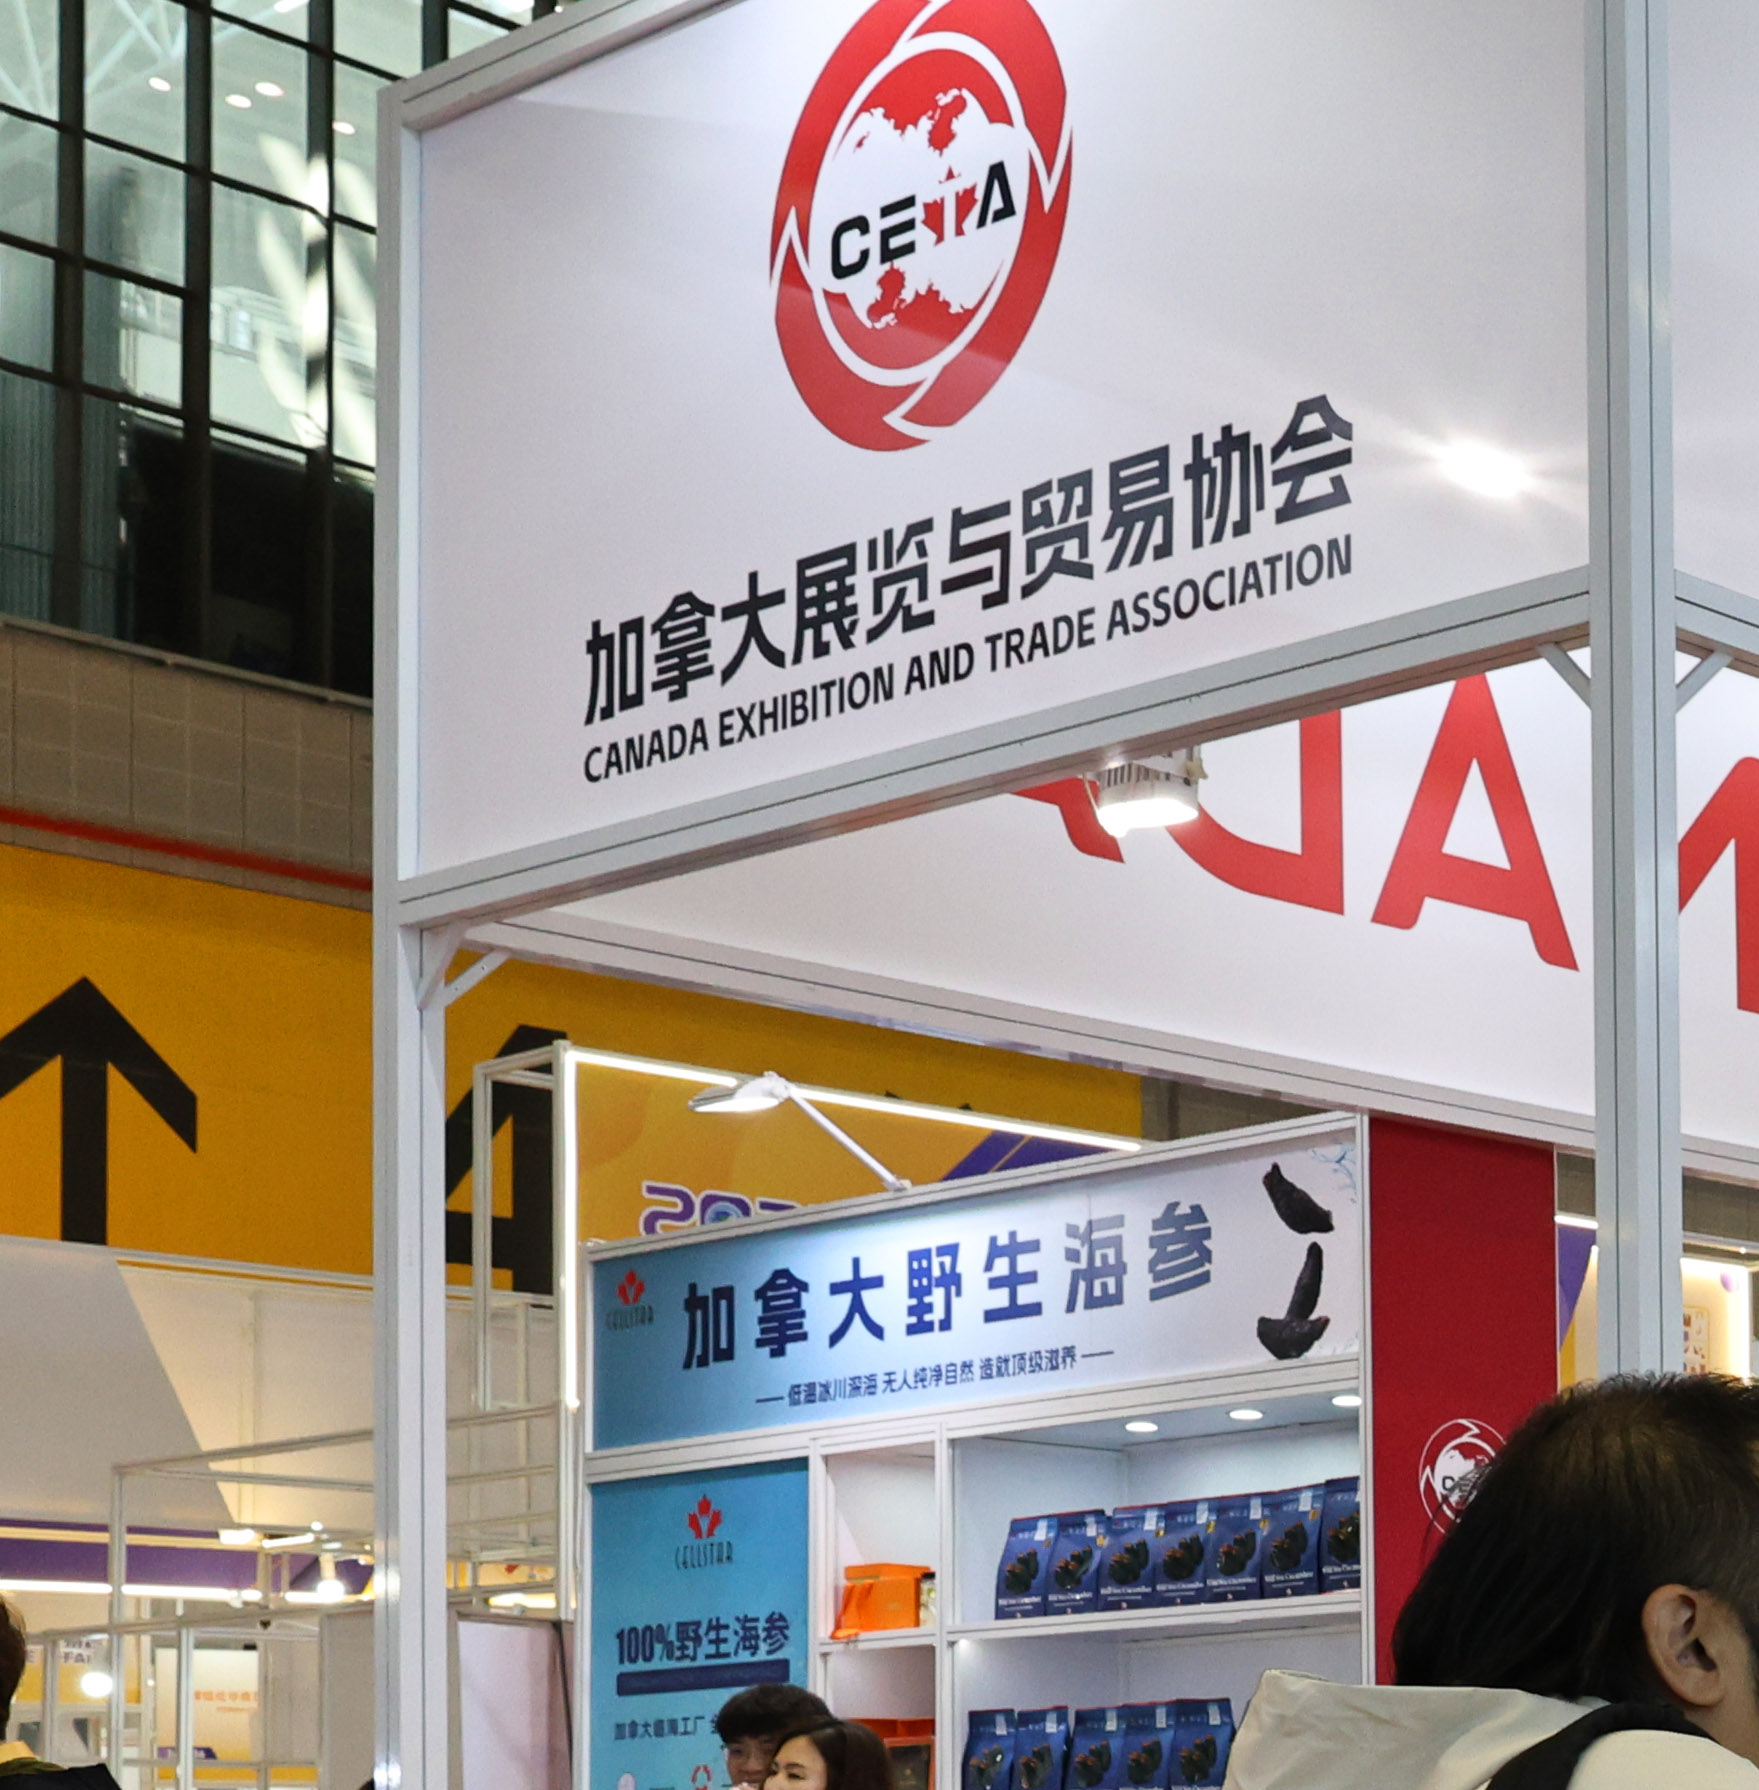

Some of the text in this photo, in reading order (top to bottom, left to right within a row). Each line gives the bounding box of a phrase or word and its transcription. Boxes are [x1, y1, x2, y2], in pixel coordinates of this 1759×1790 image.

[584, 533, 1353, 784] CANADA EXHIBITION AND TRADE ASSOCIATION
[585, 394, 1354, 727] 加拿大展览与贸易协会
[681, 1201, 1214, 1371] 加拿大野生海参
[616, 1611, 789, 1665] 100%野生海参
